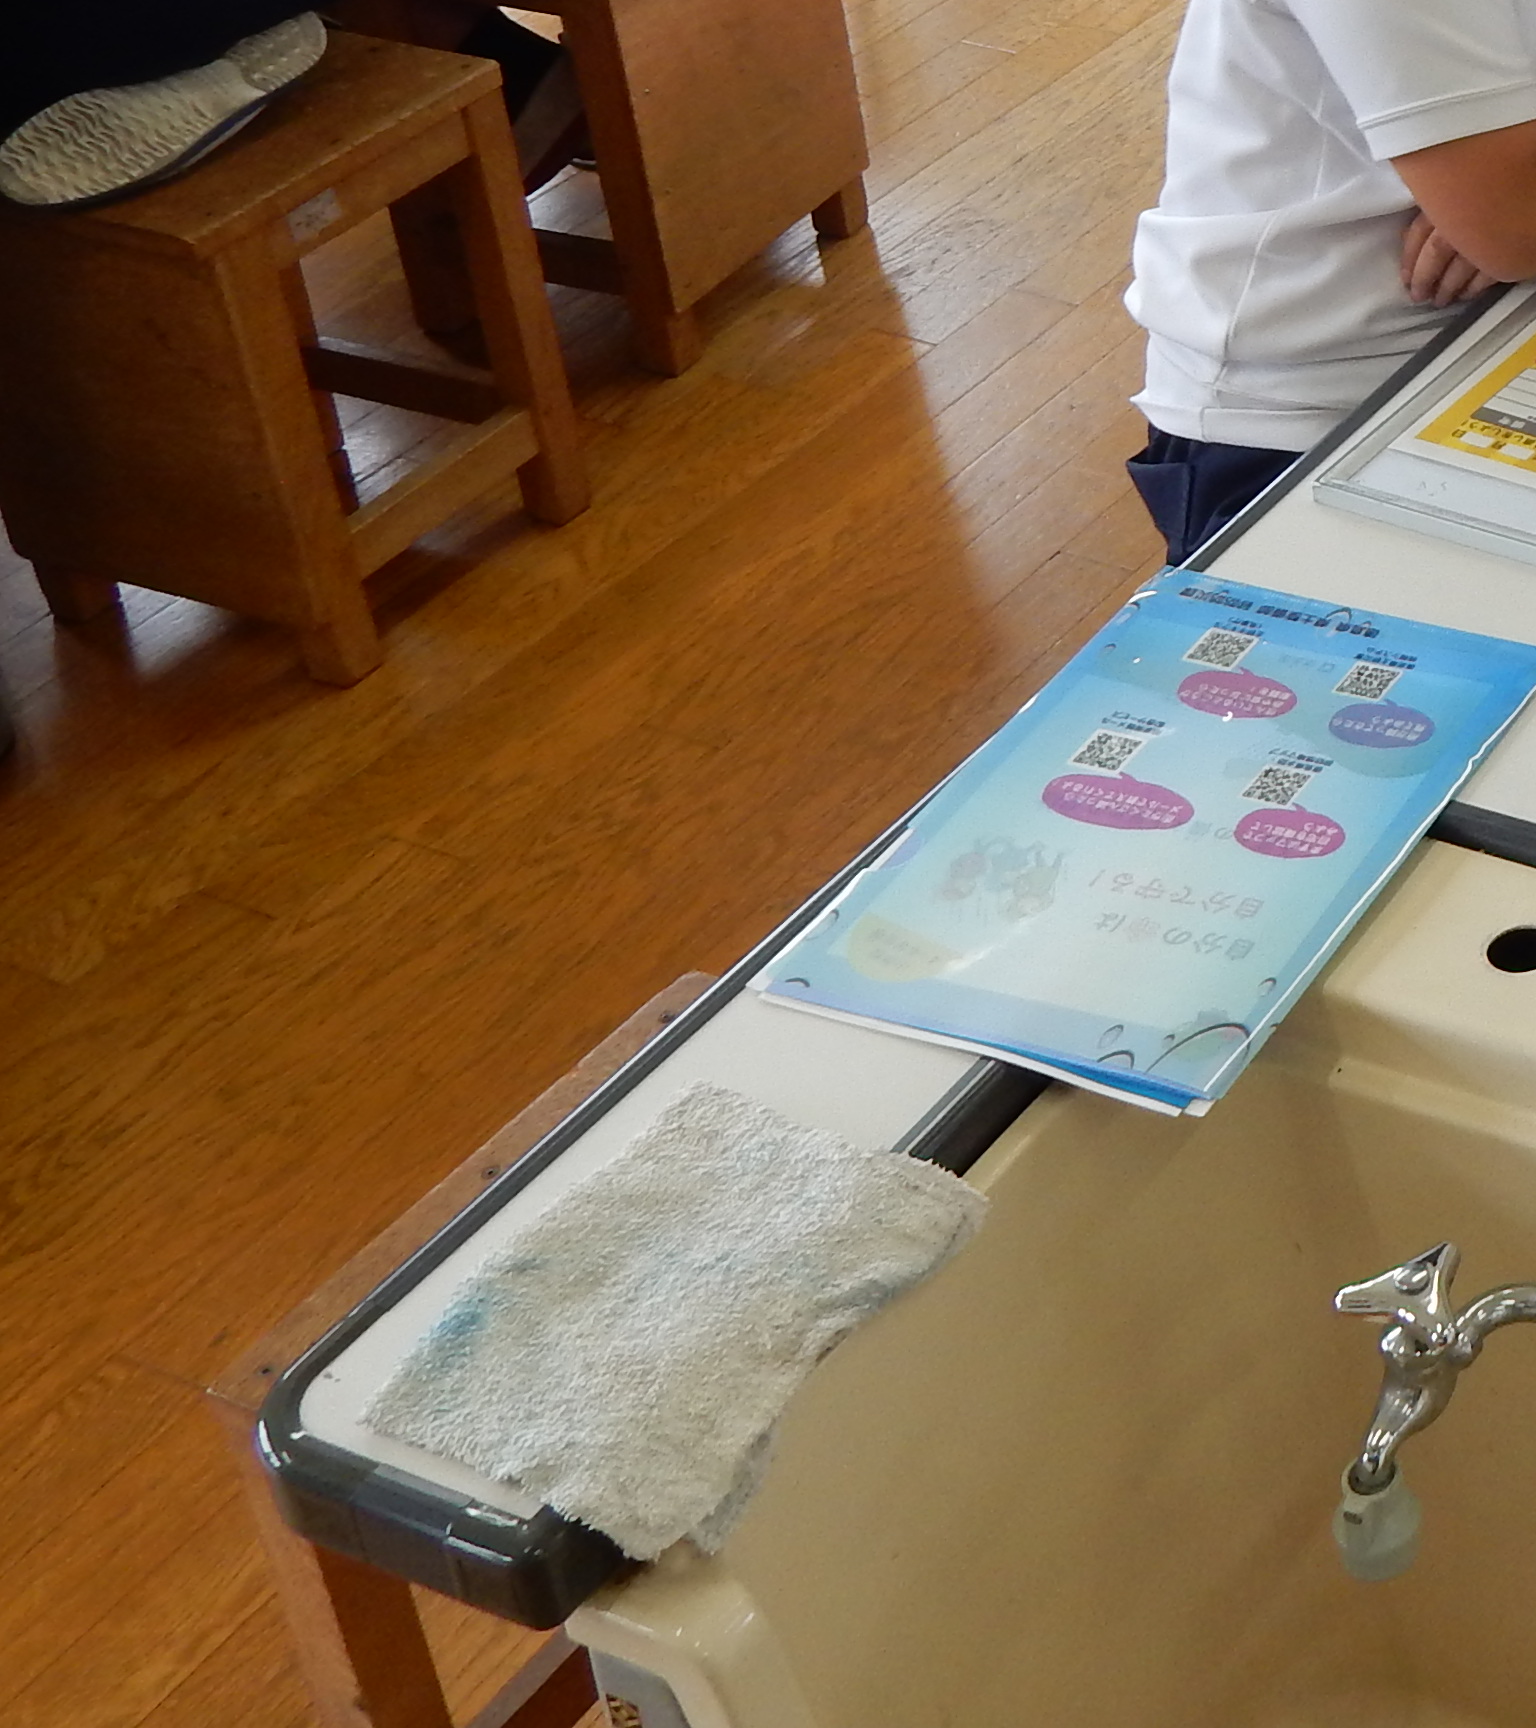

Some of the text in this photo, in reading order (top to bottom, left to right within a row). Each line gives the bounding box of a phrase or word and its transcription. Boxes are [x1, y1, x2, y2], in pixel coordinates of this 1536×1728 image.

[1088, 868, 1265, 920] 自分で守る！
